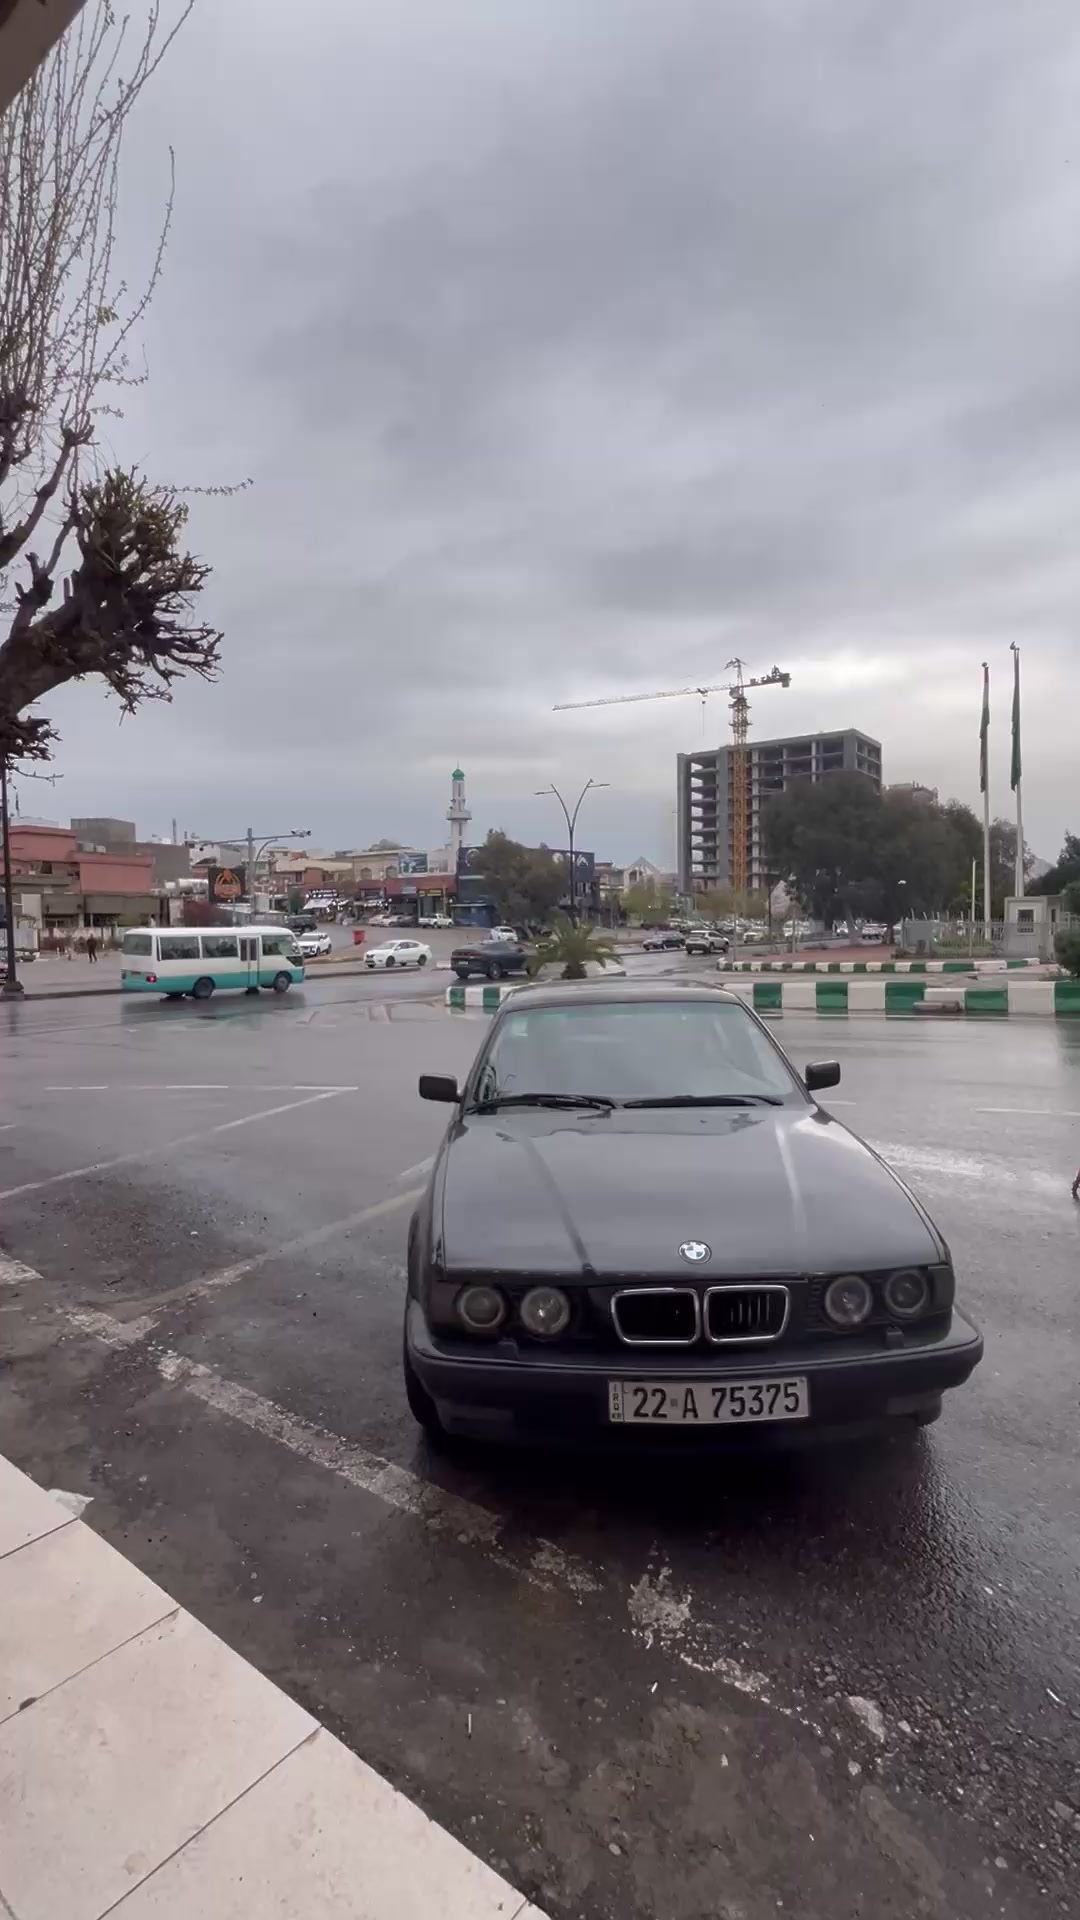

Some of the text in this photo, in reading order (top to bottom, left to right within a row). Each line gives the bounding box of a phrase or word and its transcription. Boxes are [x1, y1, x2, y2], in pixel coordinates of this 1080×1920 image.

[632, 1382, 800, 1419] 22 A 75375
